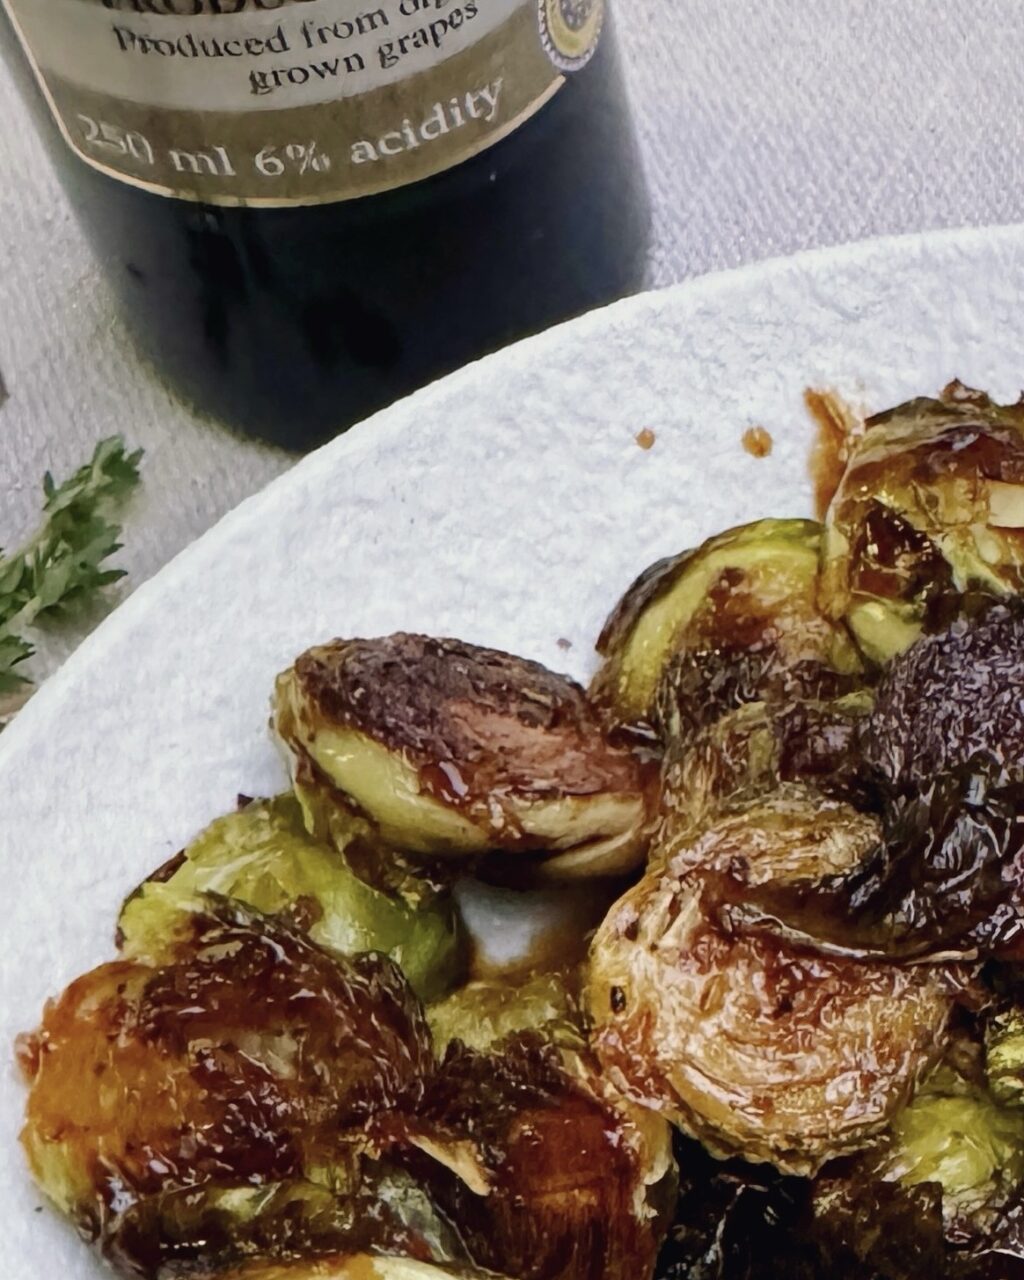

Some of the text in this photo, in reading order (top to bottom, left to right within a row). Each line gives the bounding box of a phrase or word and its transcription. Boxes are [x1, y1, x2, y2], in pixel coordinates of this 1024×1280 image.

[113, 9, 389, 58] Produced from
[249, 2, 479, 95] grown grapes
[77, 78, 503, 177] 250 ml 6% acidity
